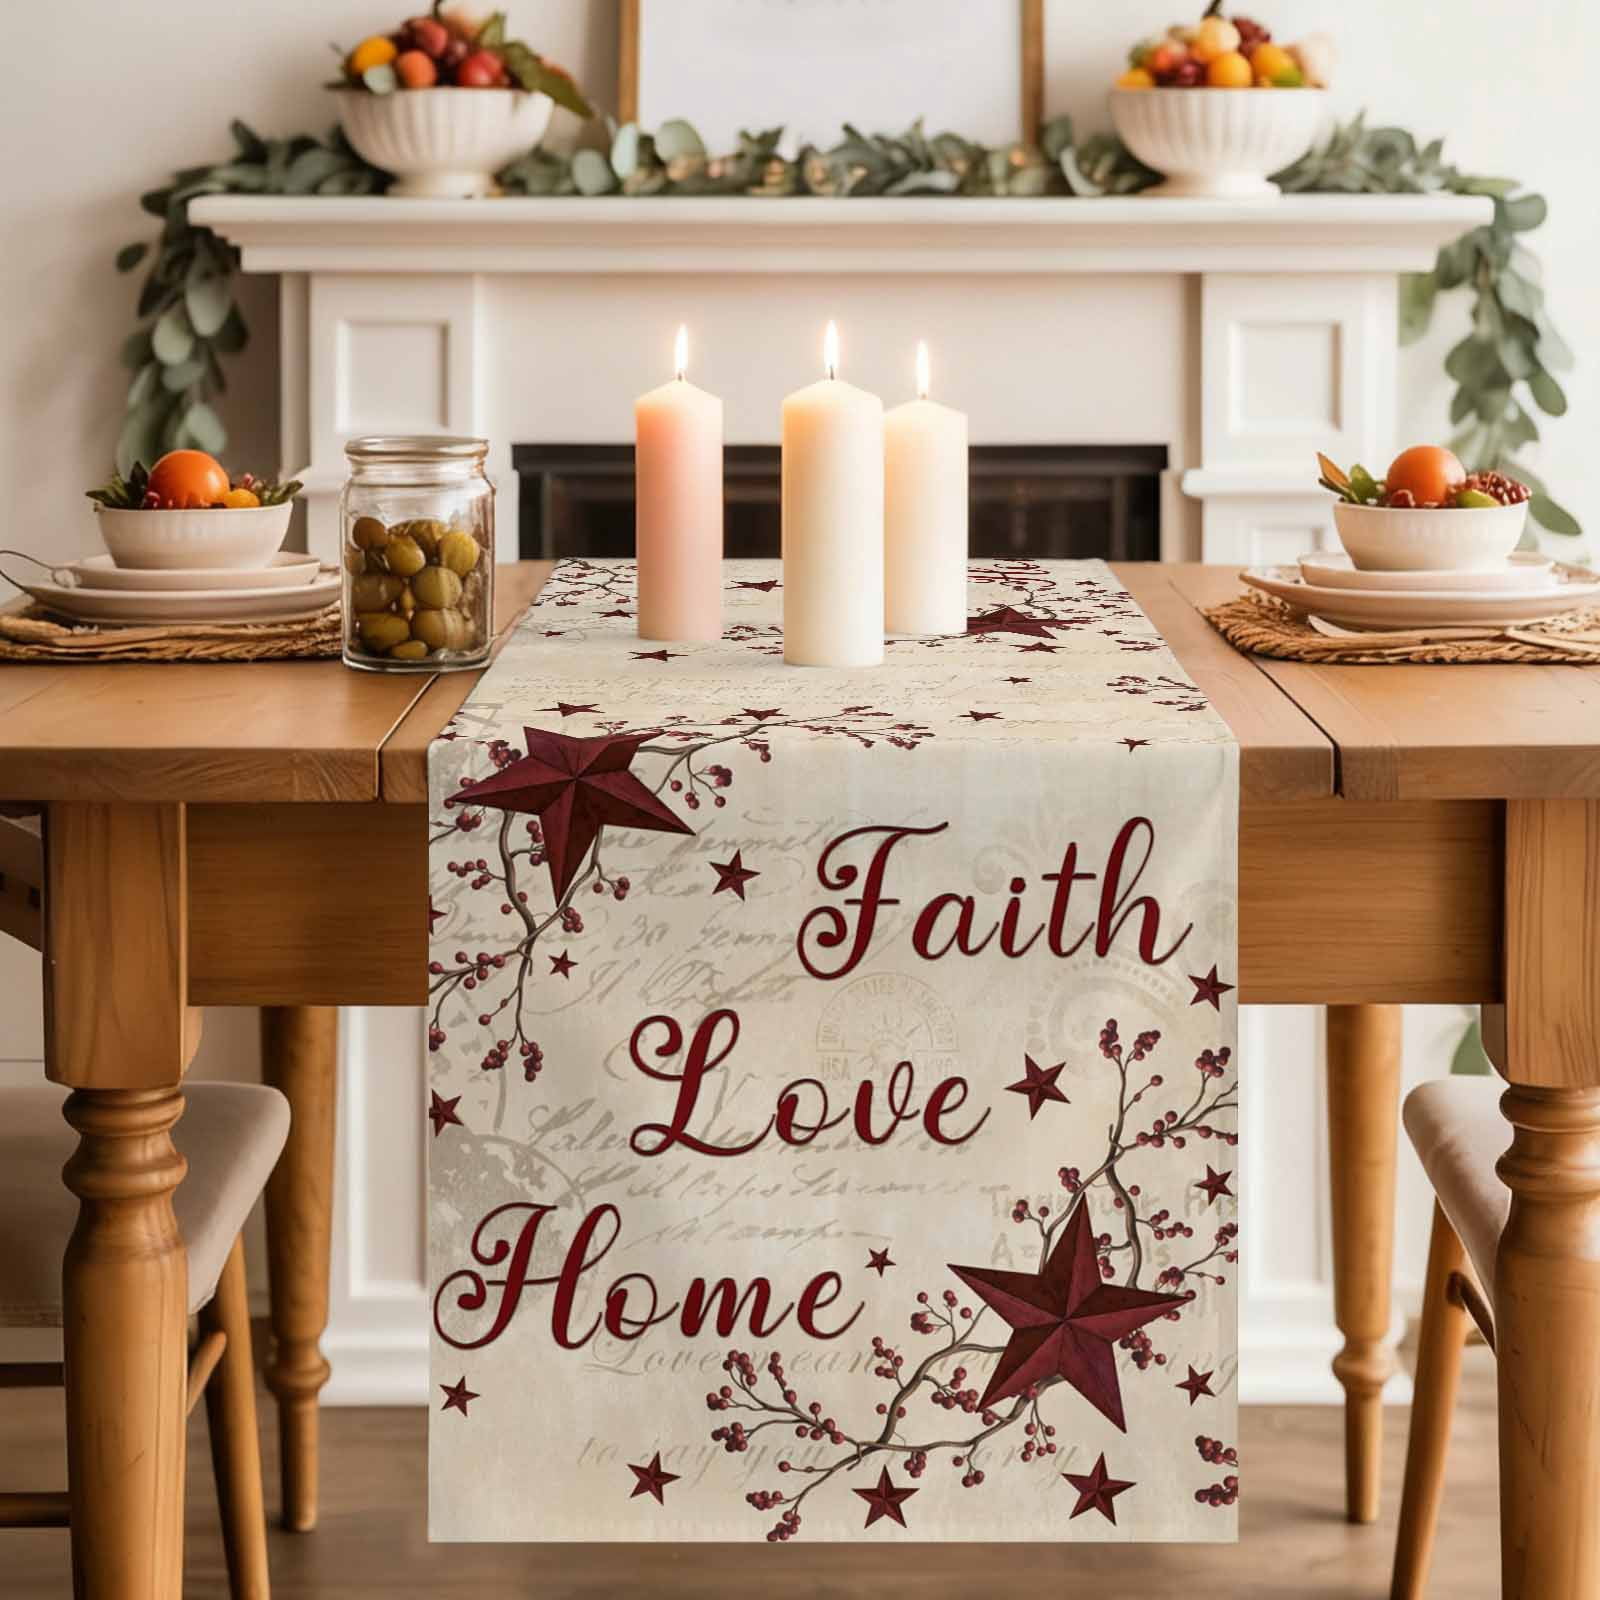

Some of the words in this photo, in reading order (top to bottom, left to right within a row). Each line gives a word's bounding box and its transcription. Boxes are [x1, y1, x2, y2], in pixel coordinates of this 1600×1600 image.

[797, 816, 1193, 980] Faith
[629, 1009, 991, 1157] Love
[433, 1202, 865, 1351] Home
